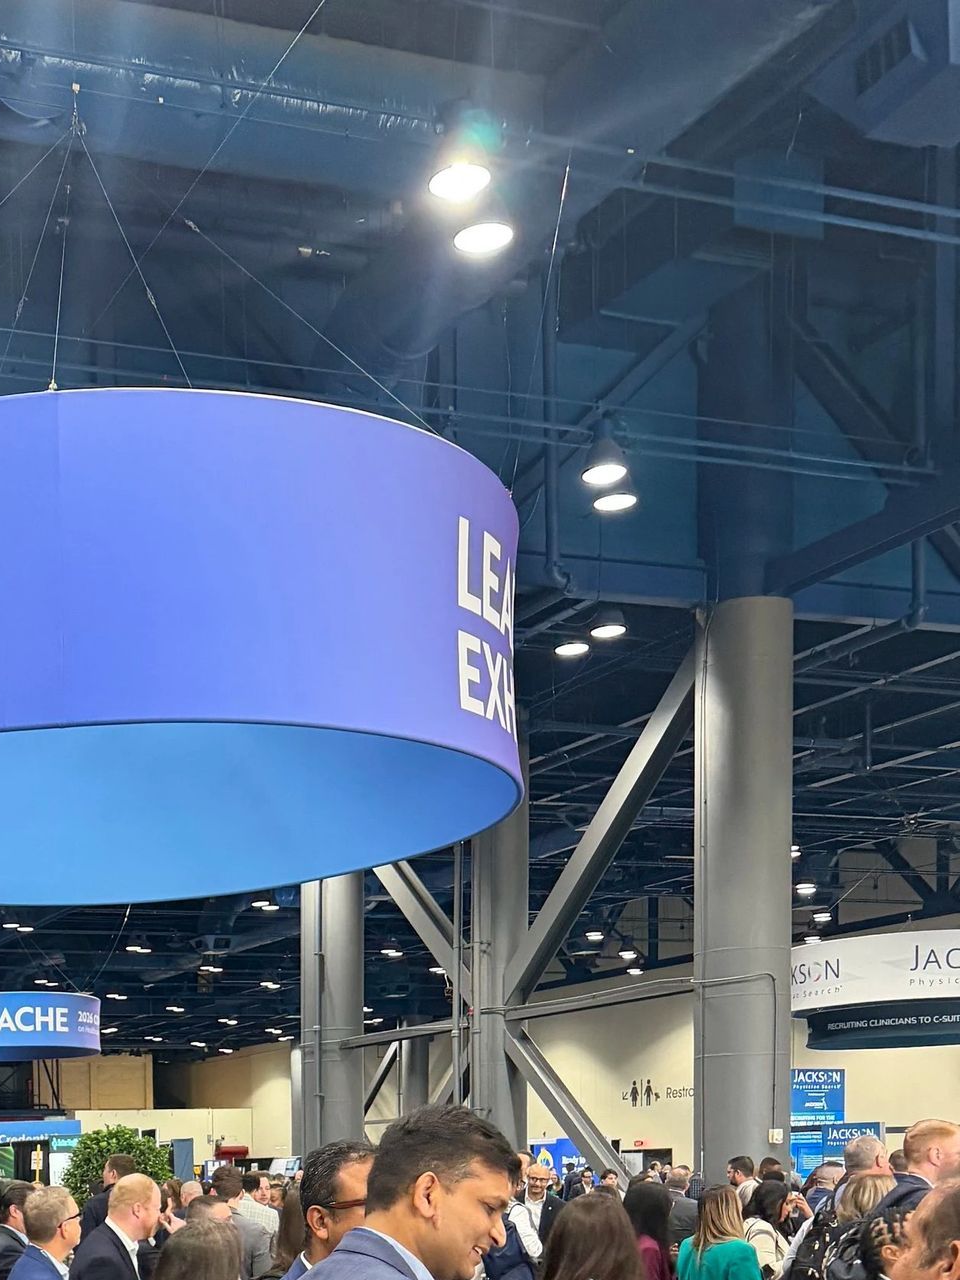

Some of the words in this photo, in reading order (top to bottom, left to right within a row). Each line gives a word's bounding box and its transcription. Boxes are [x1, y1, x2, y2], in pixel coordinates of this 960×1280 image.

[458, 516, 516, 655] LEA
[77, 1011, 93, 1024] 2026
[827, 1020, 868, 1030] RECRUITING
[869, 1017, 917, 1027] CLINICIANS
[918, 1016, 931, 1024] TO
[793, 1069, 841, 1083] JACKSON
[665, 1086, 695, 1100] Restro
